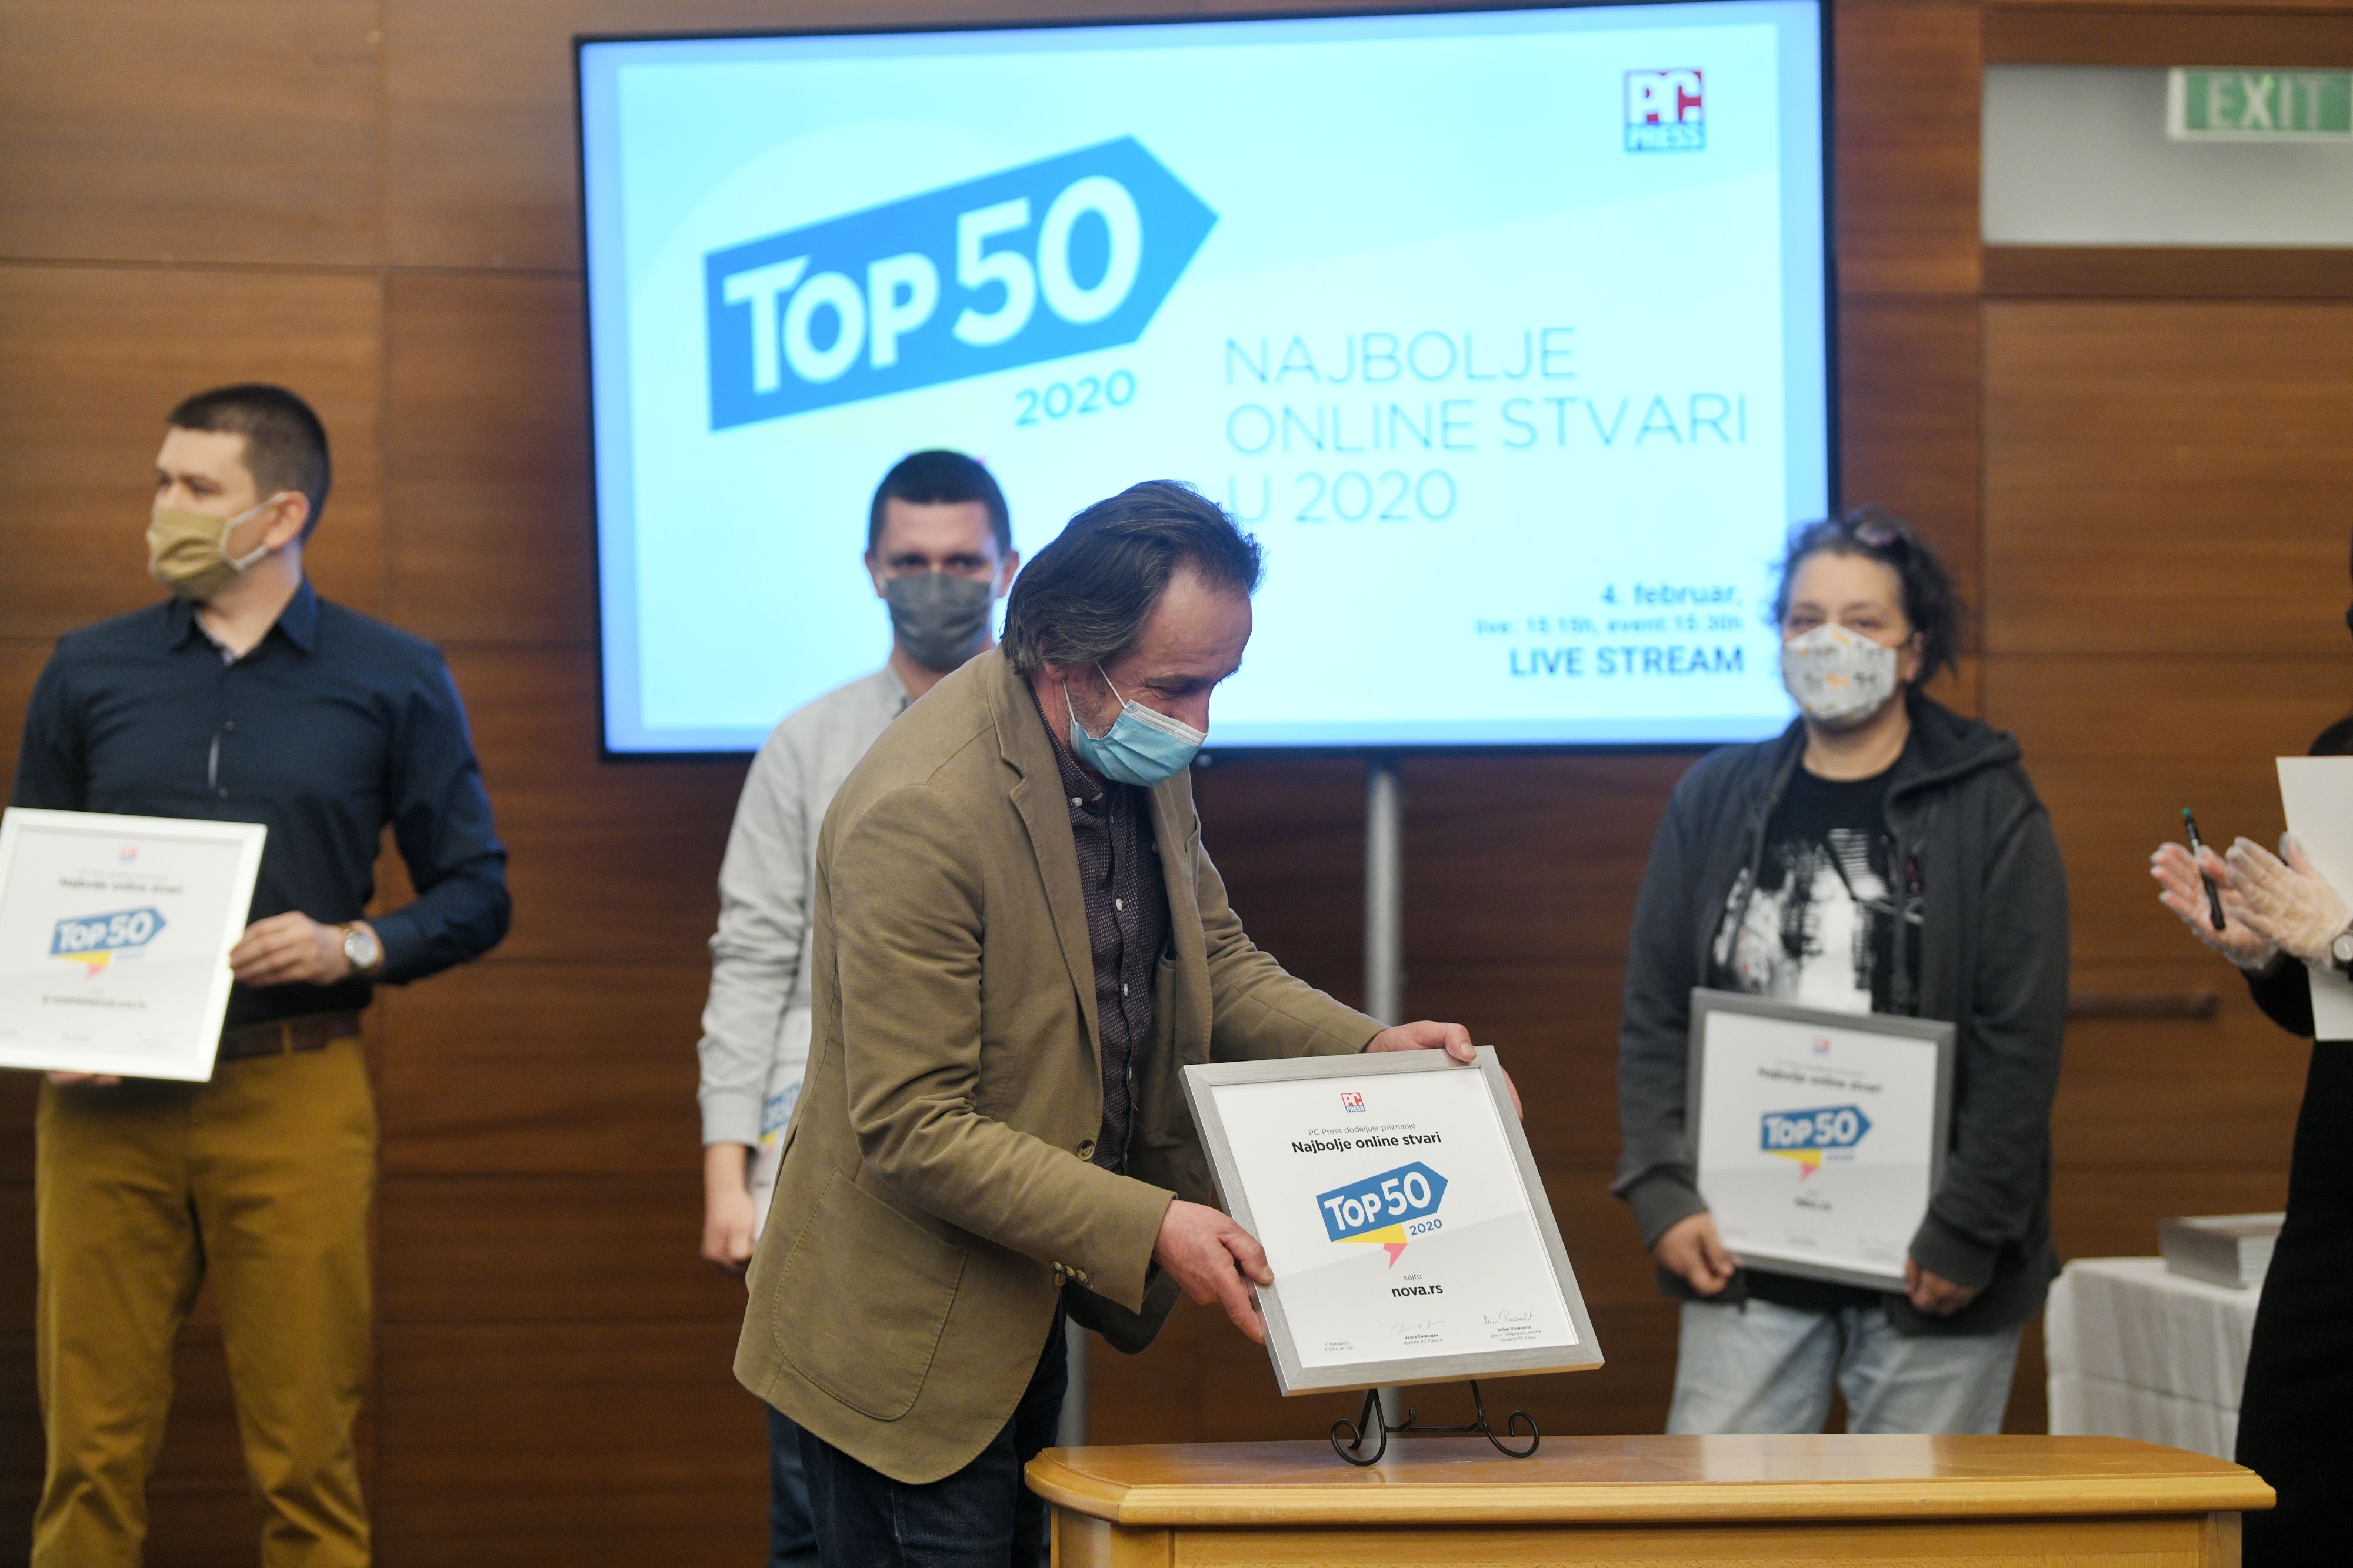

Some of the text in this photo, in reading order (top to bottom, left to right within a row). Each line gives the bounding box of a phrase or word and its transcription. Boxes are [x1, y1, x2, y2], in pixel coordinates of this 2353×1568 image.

[1628, 70, 1702, 123] PC
[2208, 71, 2329, 128] EXIT
[951, 175, 1143, 347] 50
[1224, 327, 1577, 384] NAJBOLJE
[1014, 369, 1138, 427] 2020
[1225, 393, 1748, 455] ONLINE STVARI
[1228, 469, 1458, 522] U 2020
[1600, 581, 1743, 608] 4. februar,
[1509, 644, 1745, 676] LIVE STREAM
[106, 912, 154, 946] 50
[1342, 1093, 1362, 1106] PC
[1291, 1131, 1442, 1154] Najbolje online stvari
[1321, 1127, 1342, 1135] Press
[1344, 1123, 1379, 1134] dodeljuje
[1381, 1122, 1416, 1132] priznanje
[1814, 1109, 1859, 1145] 50
[1381, 1171, 1431, 1216] 50
[1409, 1219, 1442, 1236] 2020
[1391, 1285, 1444, 1297] nova.rs
